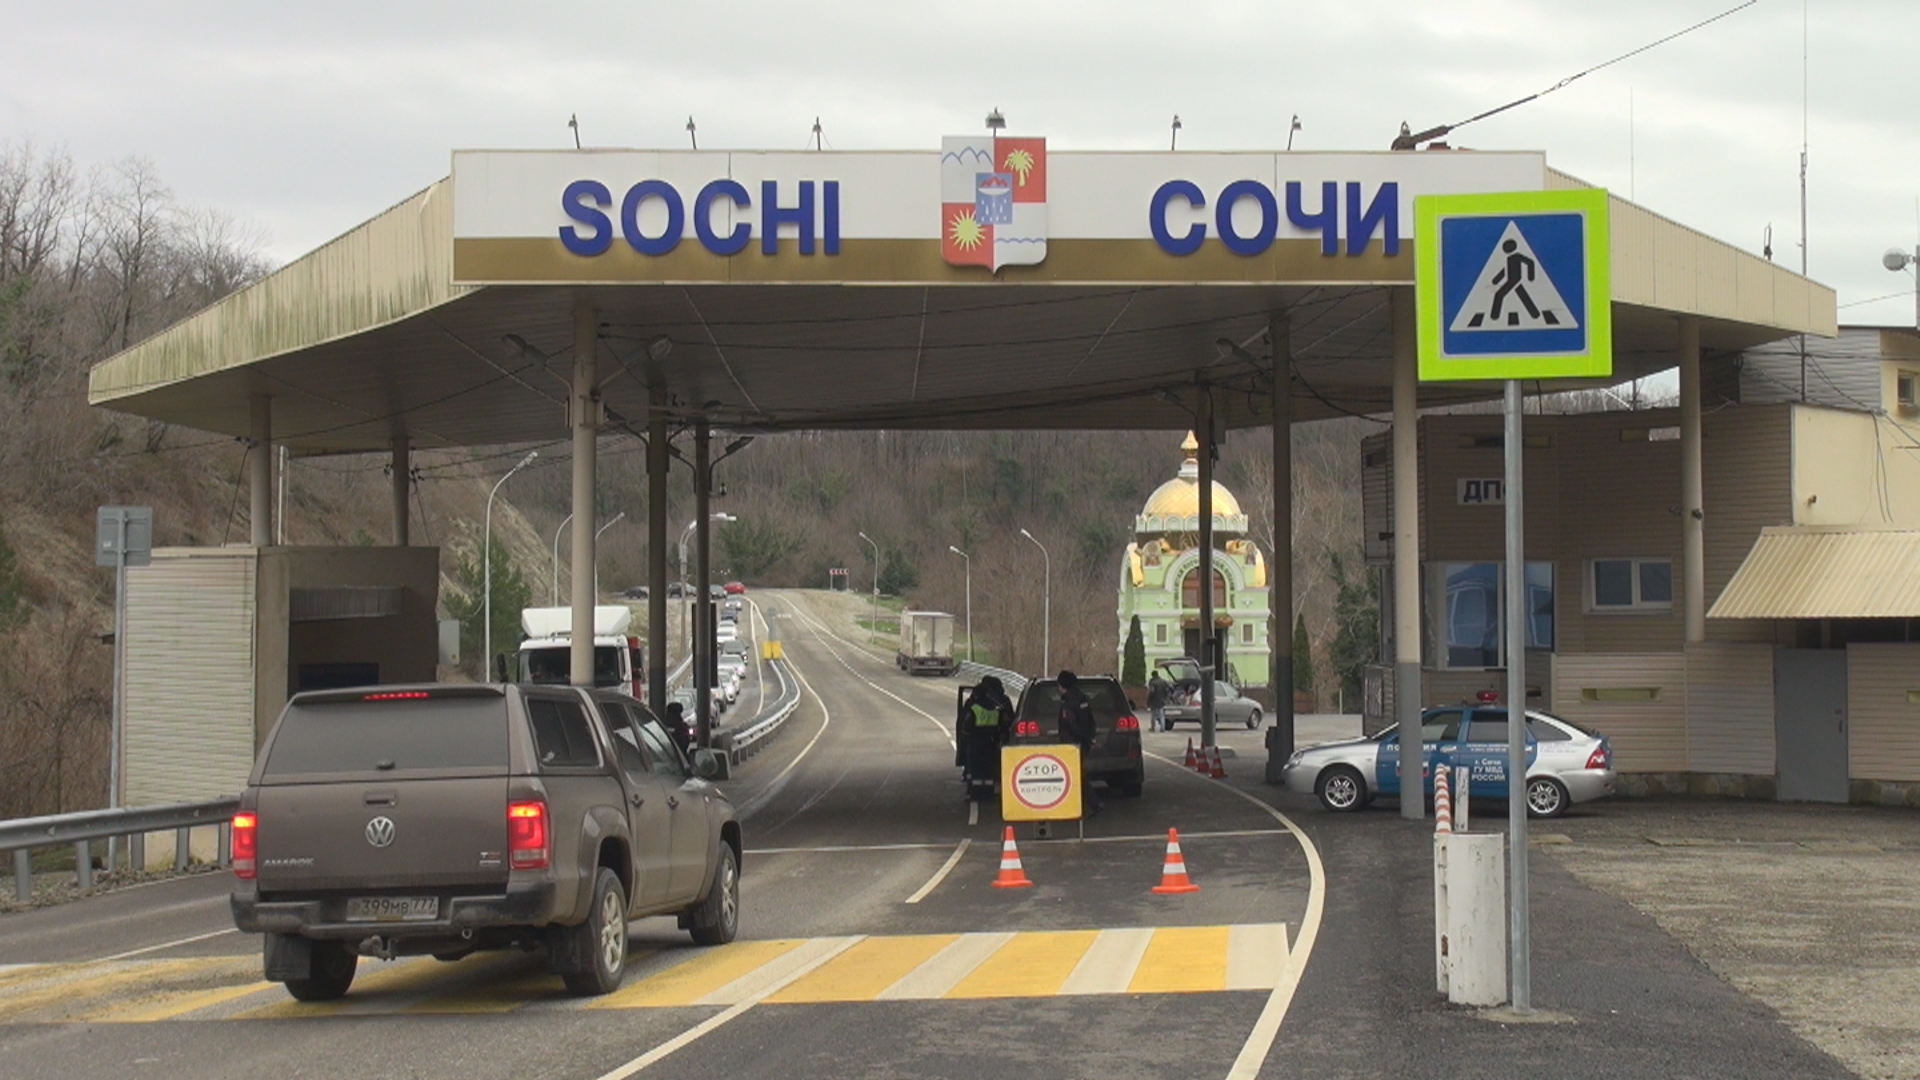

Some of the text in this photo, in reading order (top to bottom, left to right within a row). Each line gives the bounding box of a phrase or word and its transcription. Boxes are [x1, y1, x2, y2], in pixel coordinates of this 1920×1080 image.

[558, 179, 840, 257] SOCHI
[1149, 179, 1399, 257] СОЧИ
[1463, 480, 1506, 503] ДП
[1387, 743, 1437, 752] ПОИЯ
[1024, 764, 1059, 776] STOP
